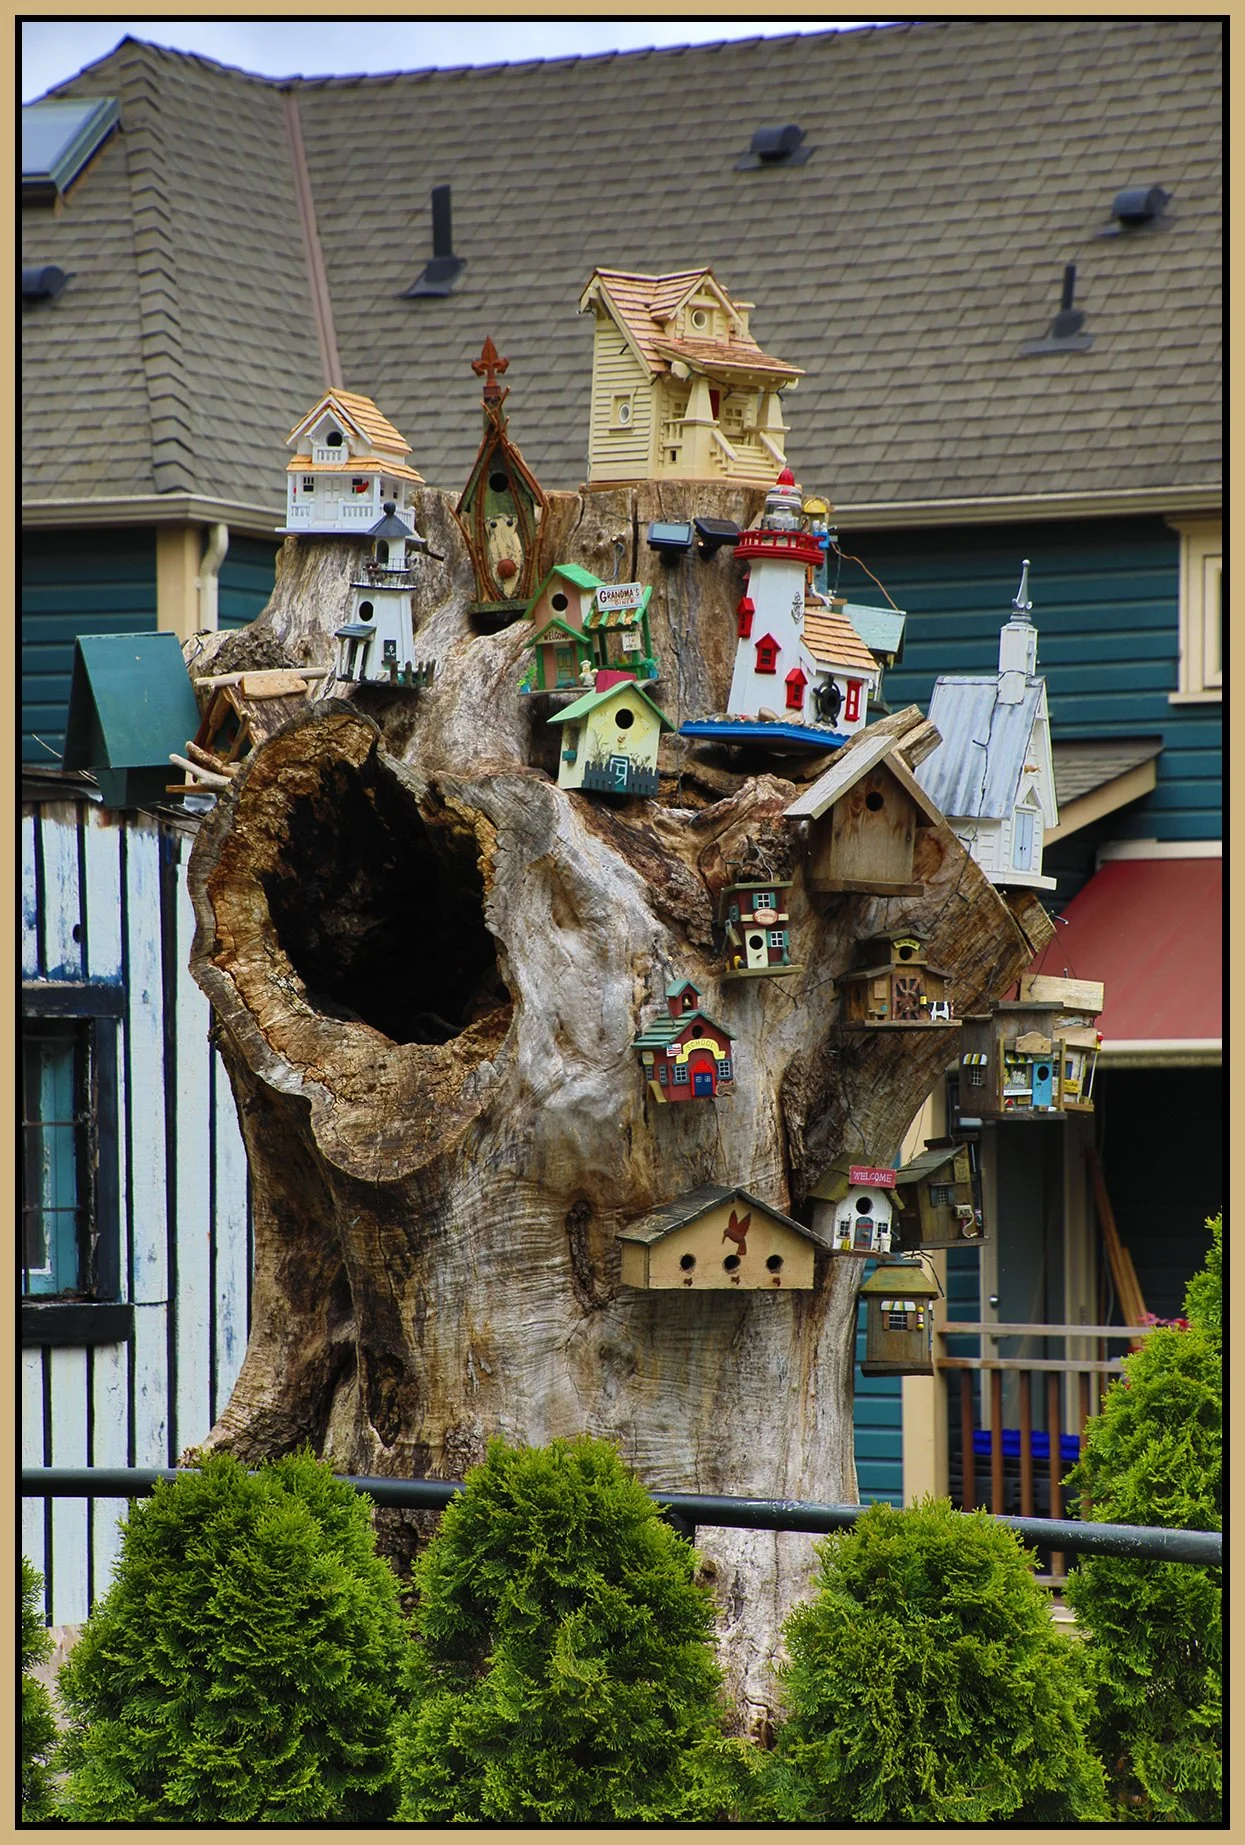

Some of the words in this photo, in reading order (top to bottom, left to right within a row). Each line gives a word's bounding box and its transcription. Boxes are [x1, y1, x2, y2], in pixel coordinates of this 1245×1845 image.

[600, 588, 640, 603] GRANDMA'S
[686, 1039, 714, 1051] SCHOOL
[853, 1170, 893, 1183] WELCOME
